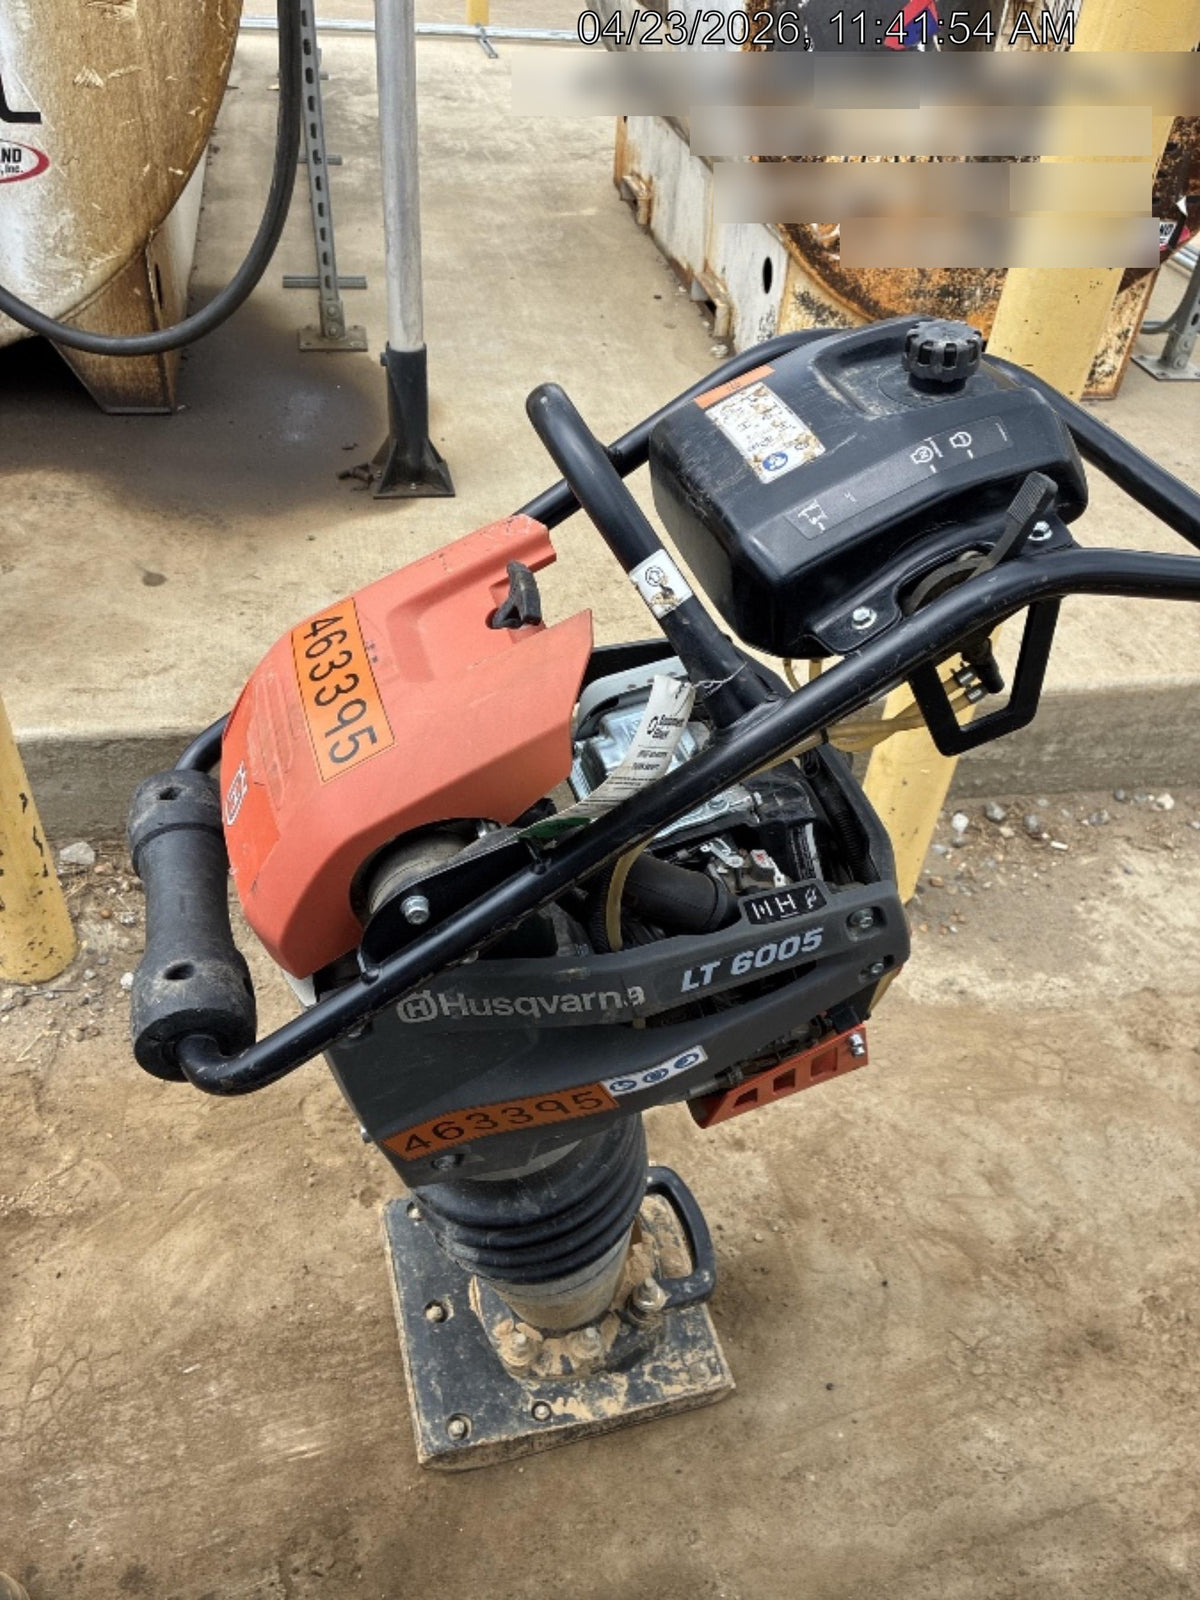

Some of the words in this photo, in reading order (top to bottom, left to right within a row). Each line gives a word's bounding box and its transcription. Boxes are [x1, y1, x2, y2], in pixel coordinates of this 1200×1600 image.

[304, 614, 378, 764] 463395
[680, 960, 727, 993] LT
[730, 926, 824, 977] 6005
[441, 983, 646, 1019] Husqvarna
[403, 1089, 605, 1155] 463395
